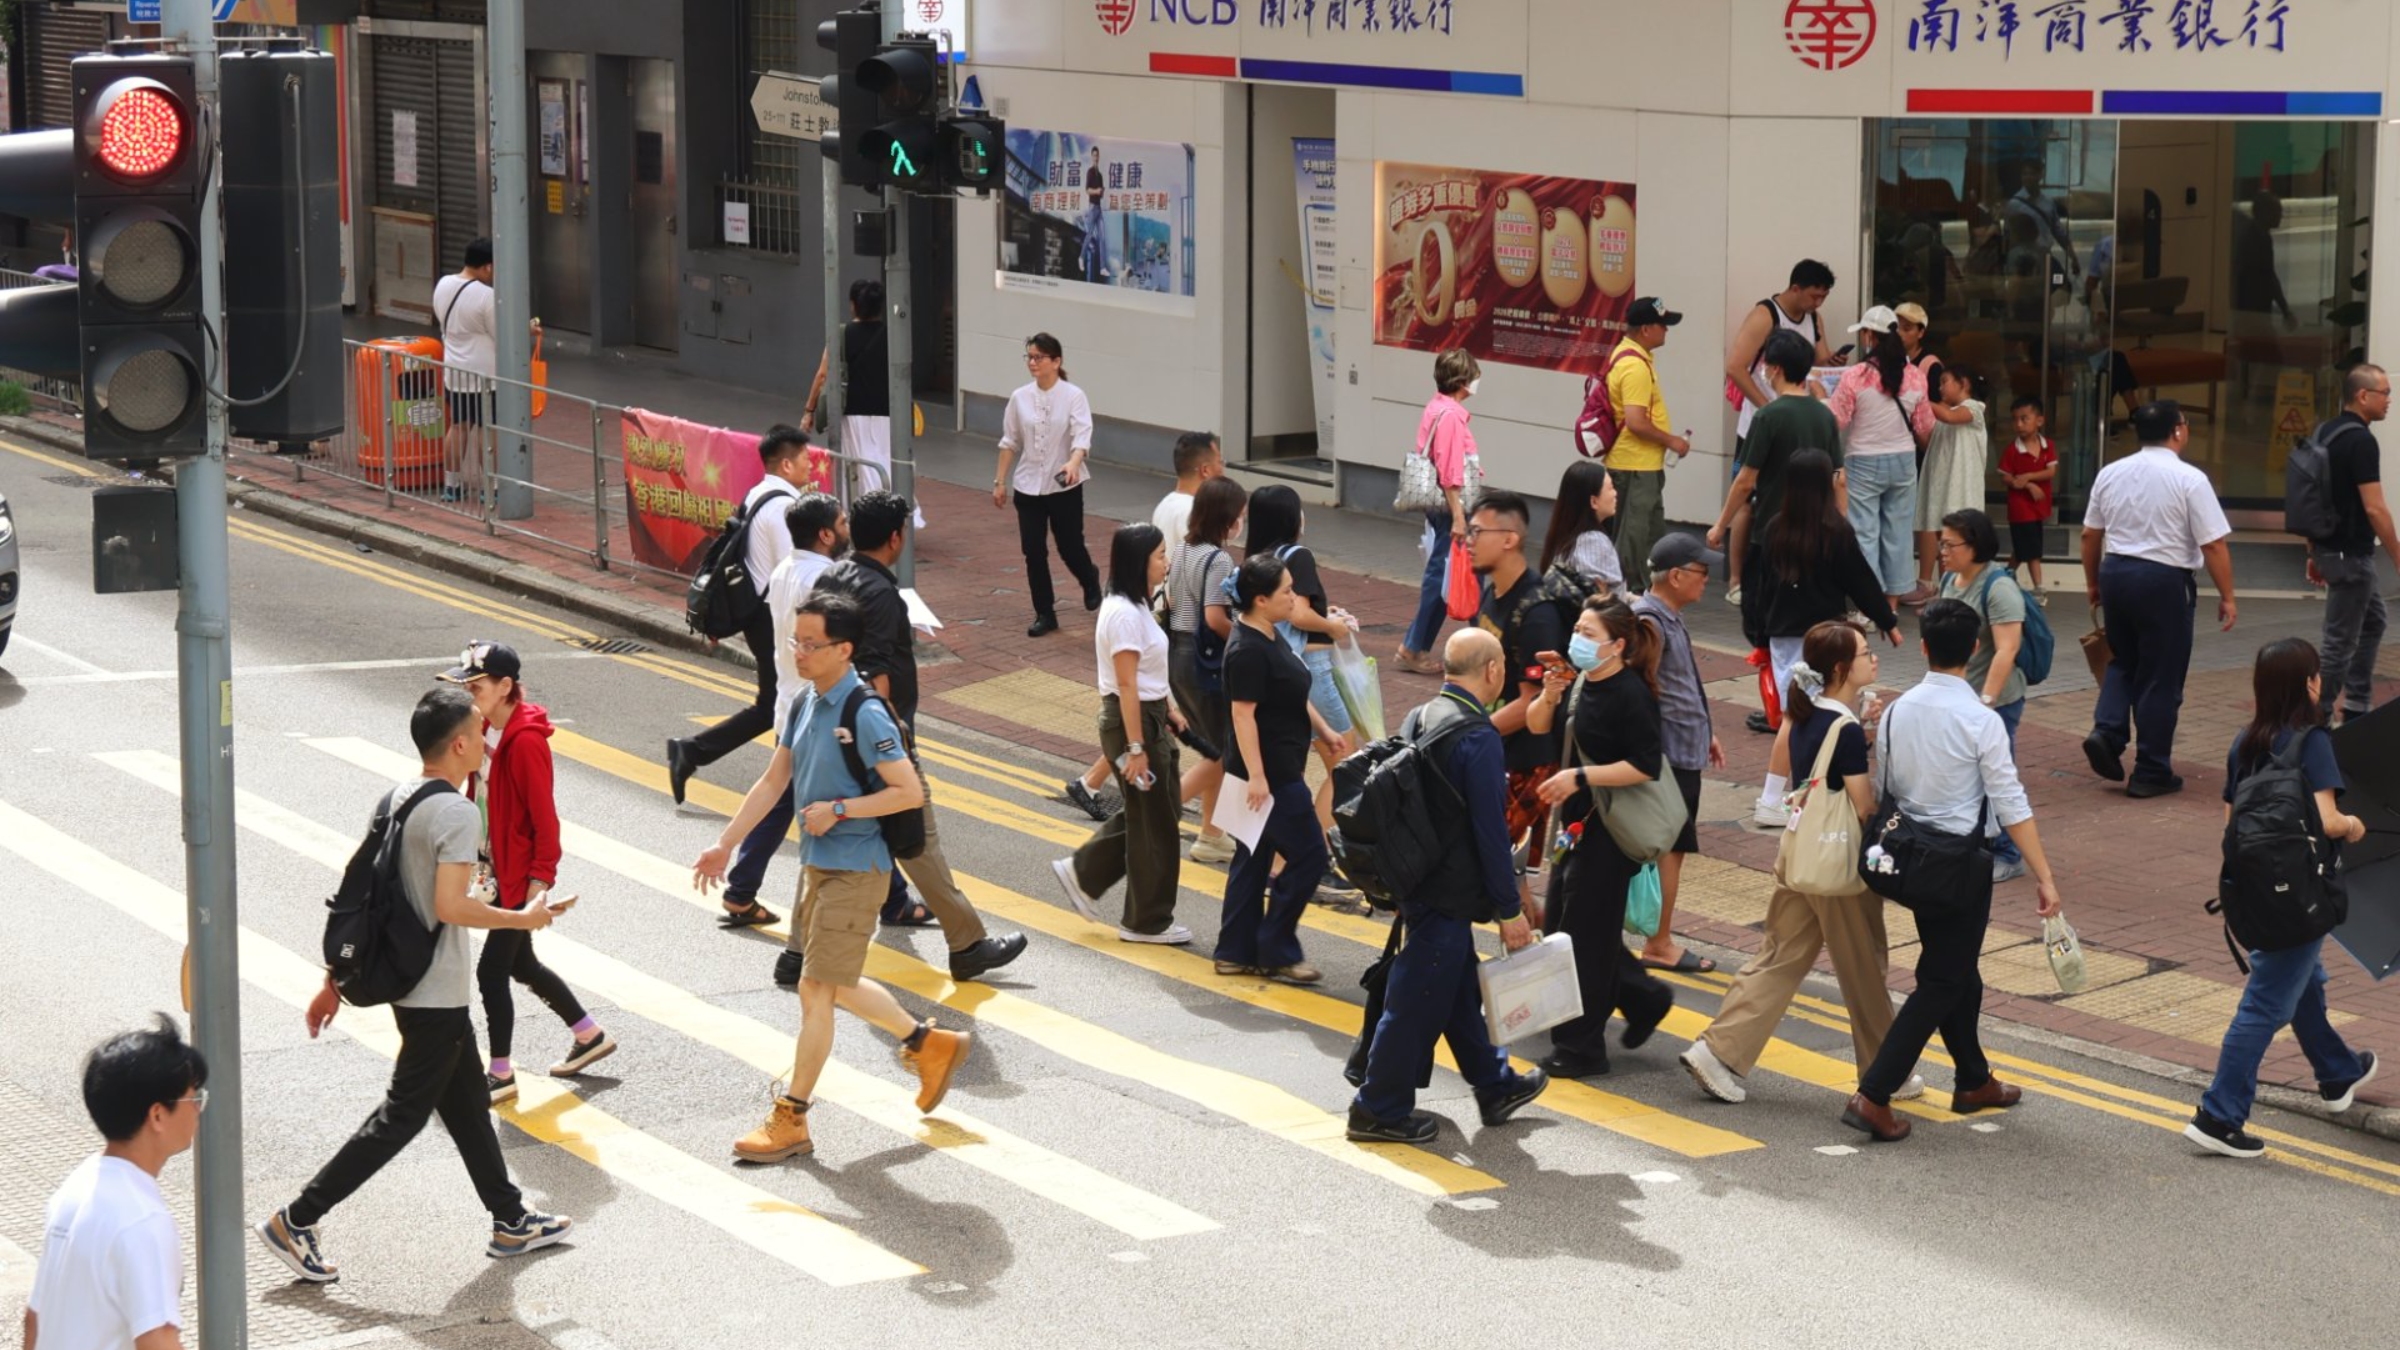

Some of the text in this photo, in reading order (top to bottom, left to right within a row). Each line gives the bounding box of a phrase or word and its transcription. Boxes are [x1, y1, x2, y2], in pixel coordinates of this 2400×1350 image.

[1150, 0, 1237, 26] NCB
[1907, 0, 2288, 62] 南洋商業銀行
[1049, 161, 1144, 189] 財富 健康
[1031, 192, 1081, 211] 南商理財
[1389, 181, 1479, 228] 證券多重優惠
